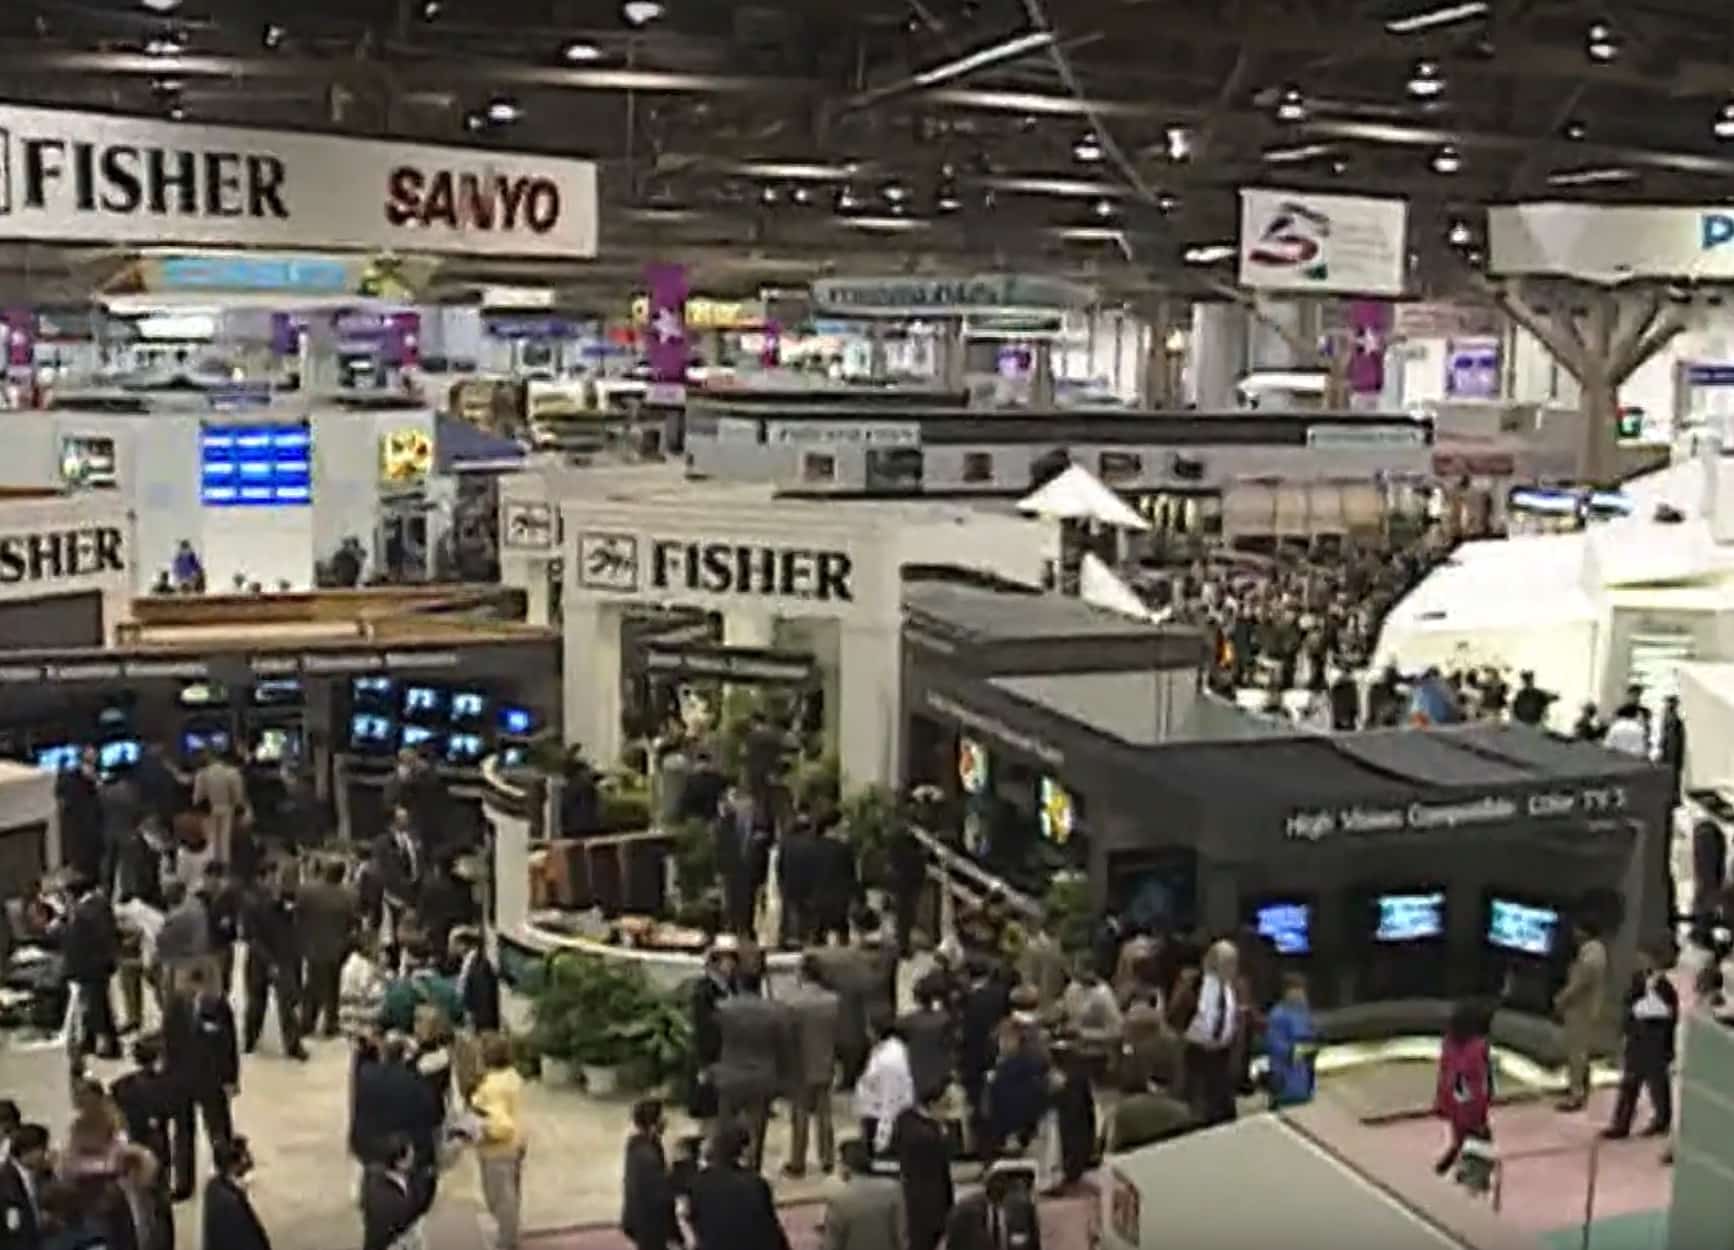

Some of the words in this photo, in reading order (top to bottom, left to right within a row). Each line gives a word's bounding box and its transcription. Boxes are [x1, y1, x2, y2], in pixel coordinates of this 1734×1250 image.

[22, 137, 289, 218] FISHER
[385, 166, 560, 233] SANYO
[653, 541, 852, 601] FISHER
